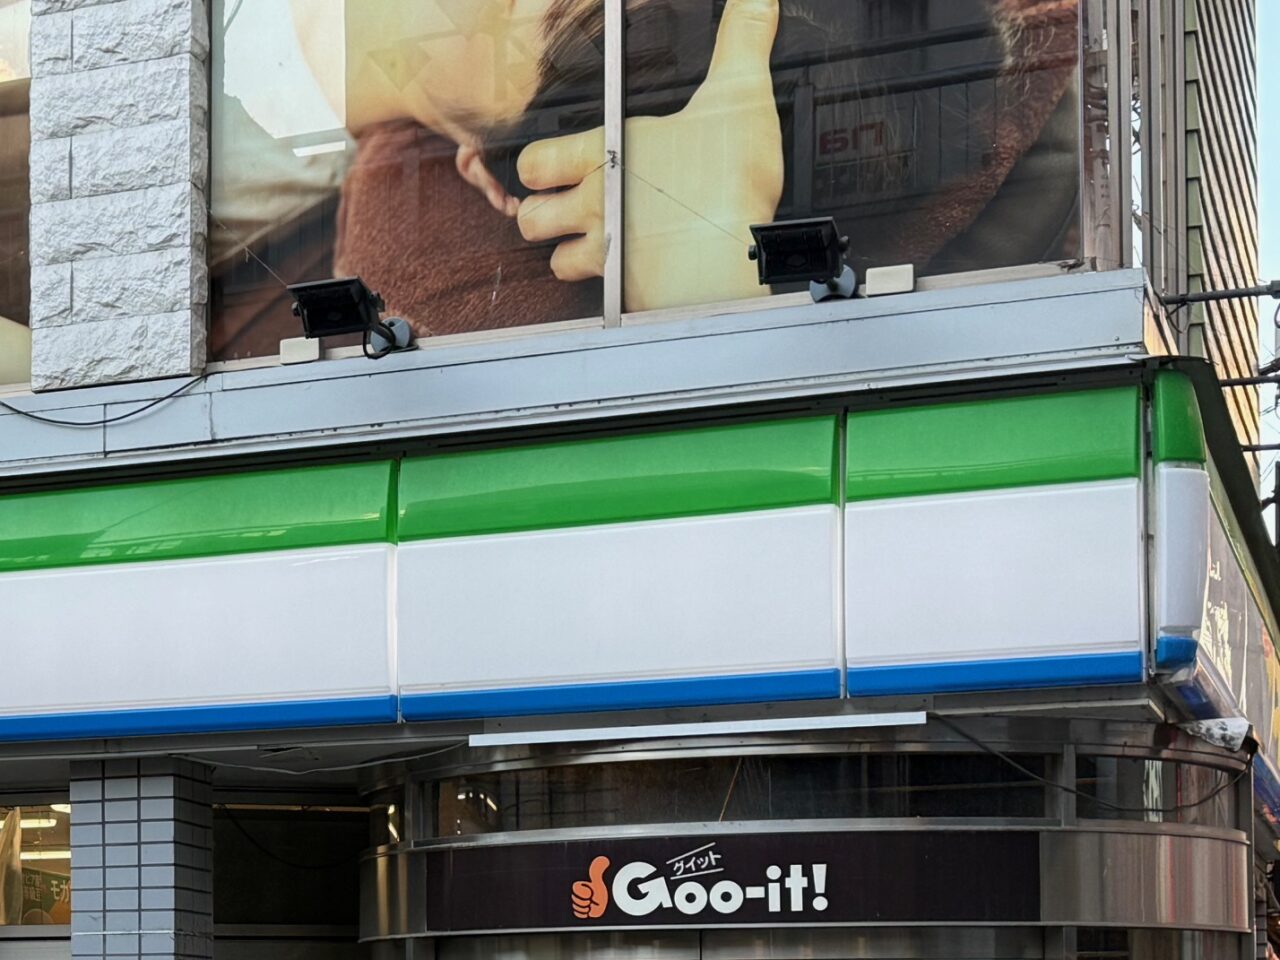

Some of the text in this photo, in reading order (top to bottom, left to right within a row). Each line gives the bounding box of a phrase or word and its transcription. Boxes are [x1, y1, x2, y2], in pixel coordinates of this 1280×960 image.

[672, 850, 722, 876] グイット
[612, 861, 829, 916] Goo-it!
